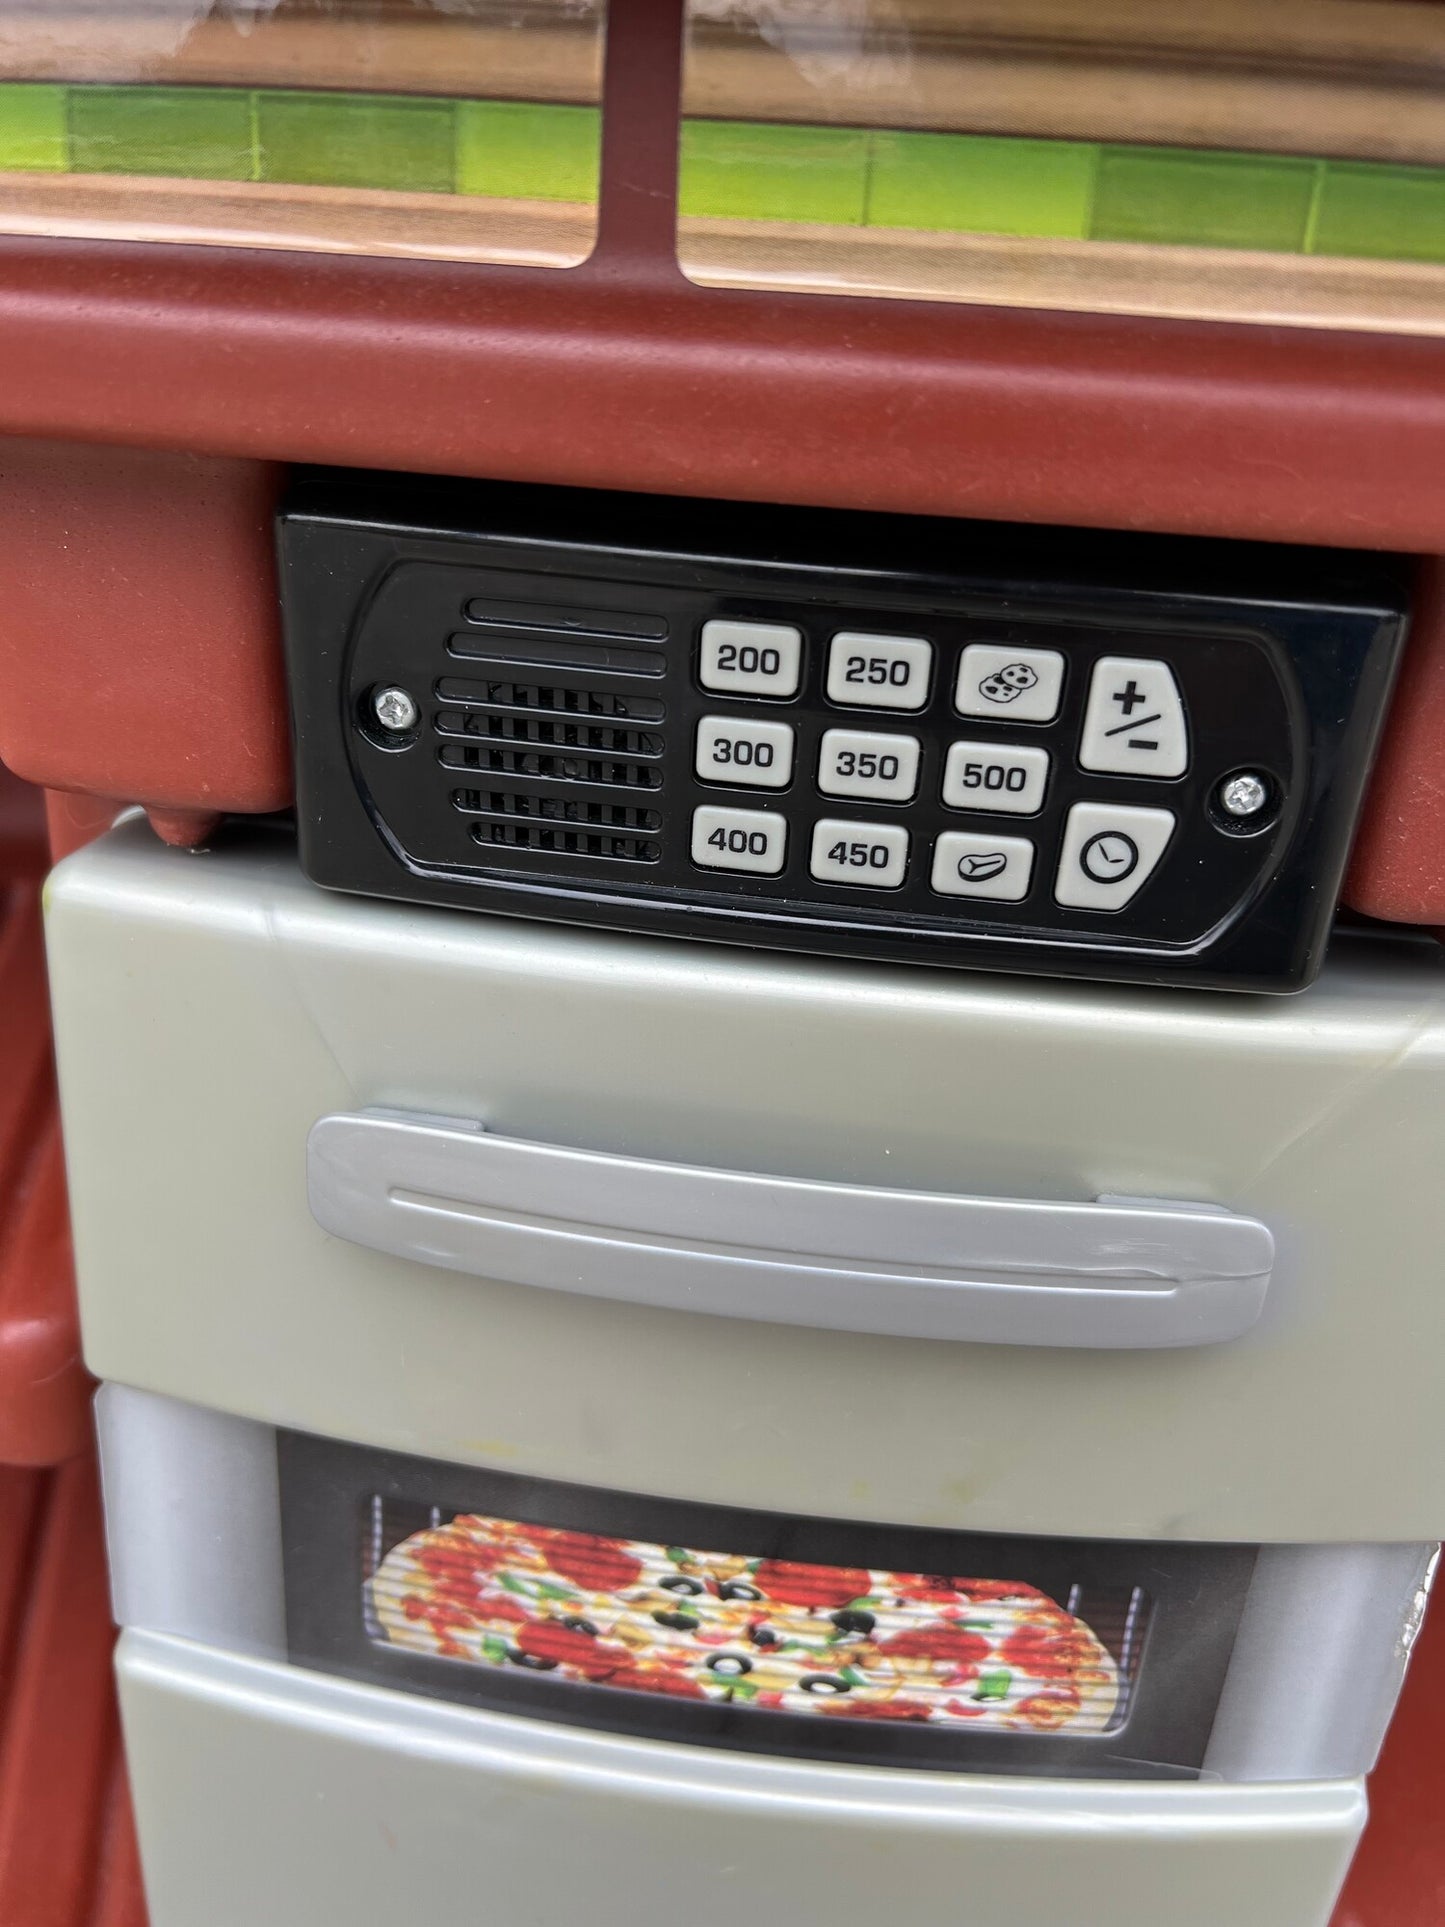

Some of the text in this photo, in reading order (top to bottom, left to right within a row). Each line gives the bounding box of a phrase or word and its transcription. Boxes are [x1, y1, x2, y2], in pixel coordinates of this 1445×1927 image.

[717, 644, 781, 676] 200
[845, 656, 911, 687] 250
[711, 737, 775, 769] 300
[835, 750, 900, 781] 350
[962, 763, 1027, 793] 500
[707, 827, 768, 856] 400
[827, 840, 890, 870] 450
